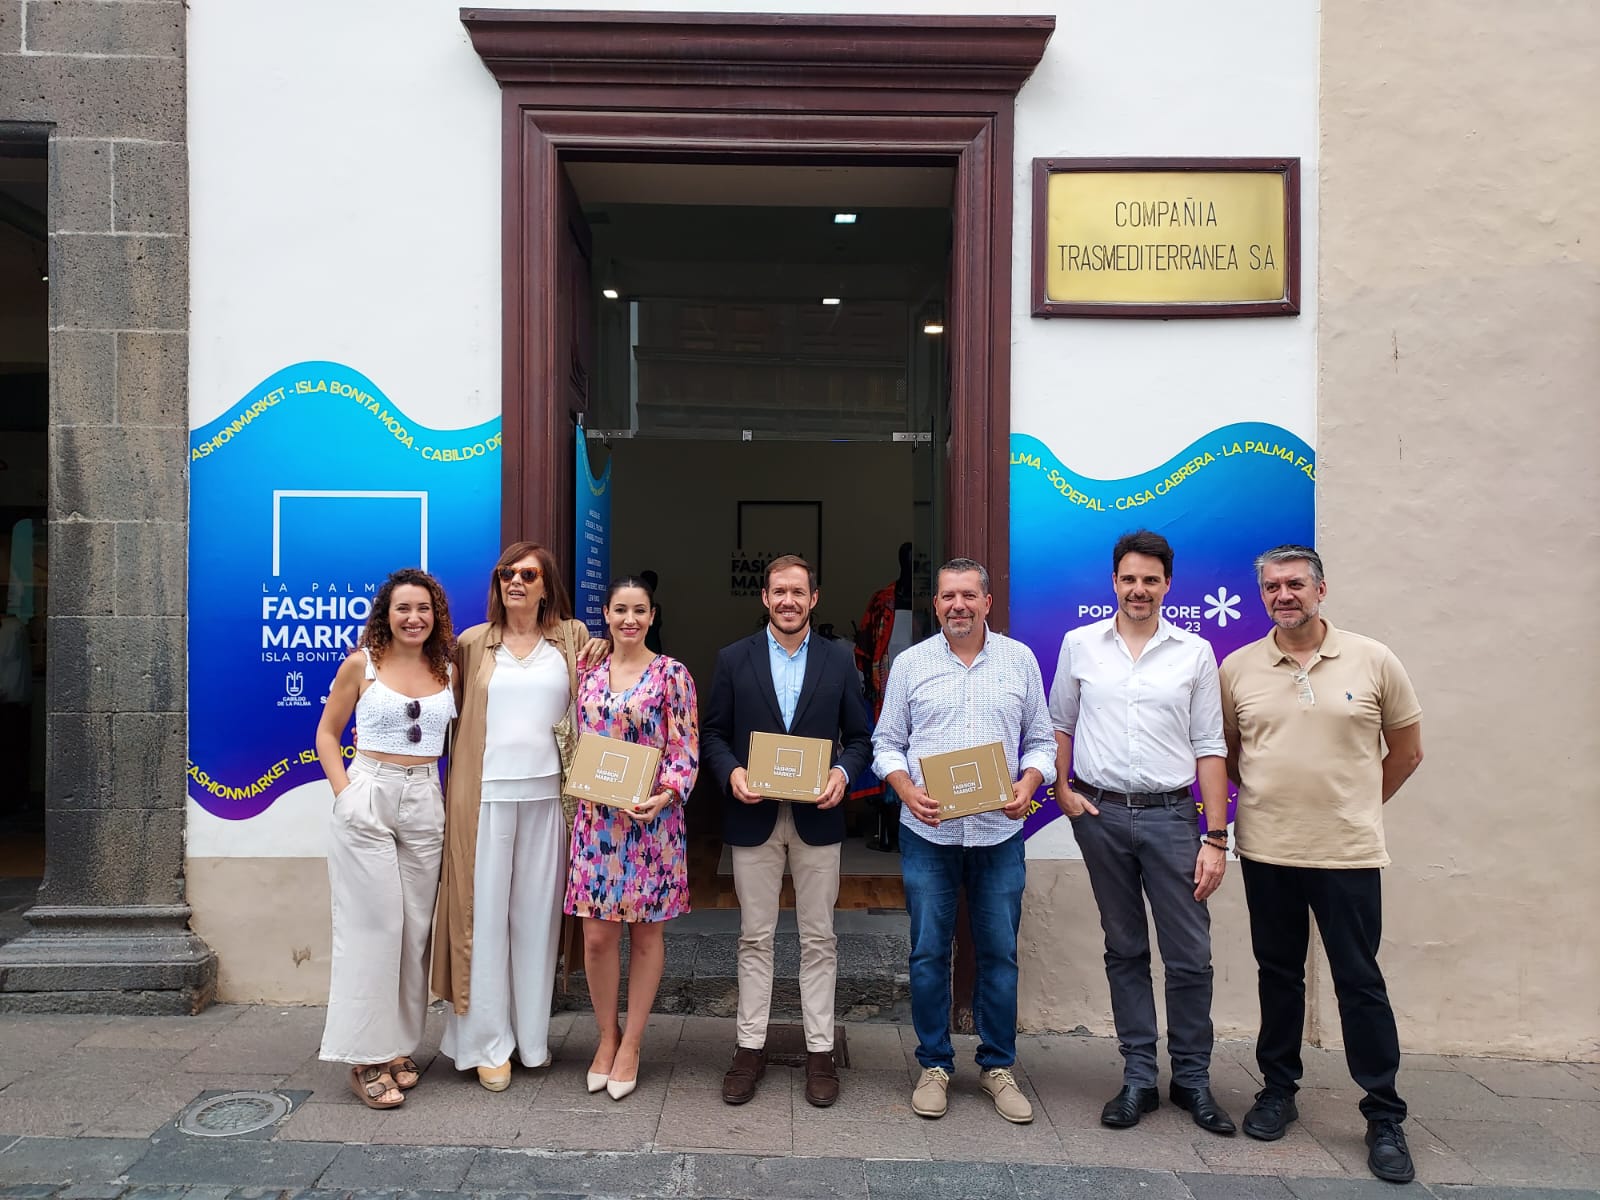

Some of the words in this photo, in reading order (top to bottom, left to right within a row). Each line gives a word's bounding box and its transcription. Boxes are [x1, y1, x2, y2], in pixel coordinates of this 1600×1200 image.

[1114, 196, 1218, 228] COMPAÑIA
[1057, 244, 1239, 272] TRASMEDITERRANEA
[1249, 244, 1279, 272] S.A.
[295, 380, 328, 395] ISLA
[329, 380, 380, 416] BONITA
[377, 409, 414, 449] MODA
[421, 443, 486, 462] CABILDO
[1009, 451, 1041, 470] LMA
[1046, 469, 1106, 512] SODEPAL
[1115, 490, 1156, 511] CASA
[1155, 452, 1216, 496] CABRERA
[1222, 442, 1243, 457] LA
[1244, 440, 1294, 464] PALMA
[262, 583, 288, 593] LA
[312, 583, 375, 593] PALM
[262, 596, 376, 620] FASHIO
[1078, 605, 1114, 618] POP
[1159, 605, 1201, 619] TORE
[262, 625, 366, 649] MARK
[1185, 621, 1201, 632] 23
[262, 652, 291, 662] ISLA
[296, 652, 347, 662] BONITA
[299, 748, 320, 765] ISL
